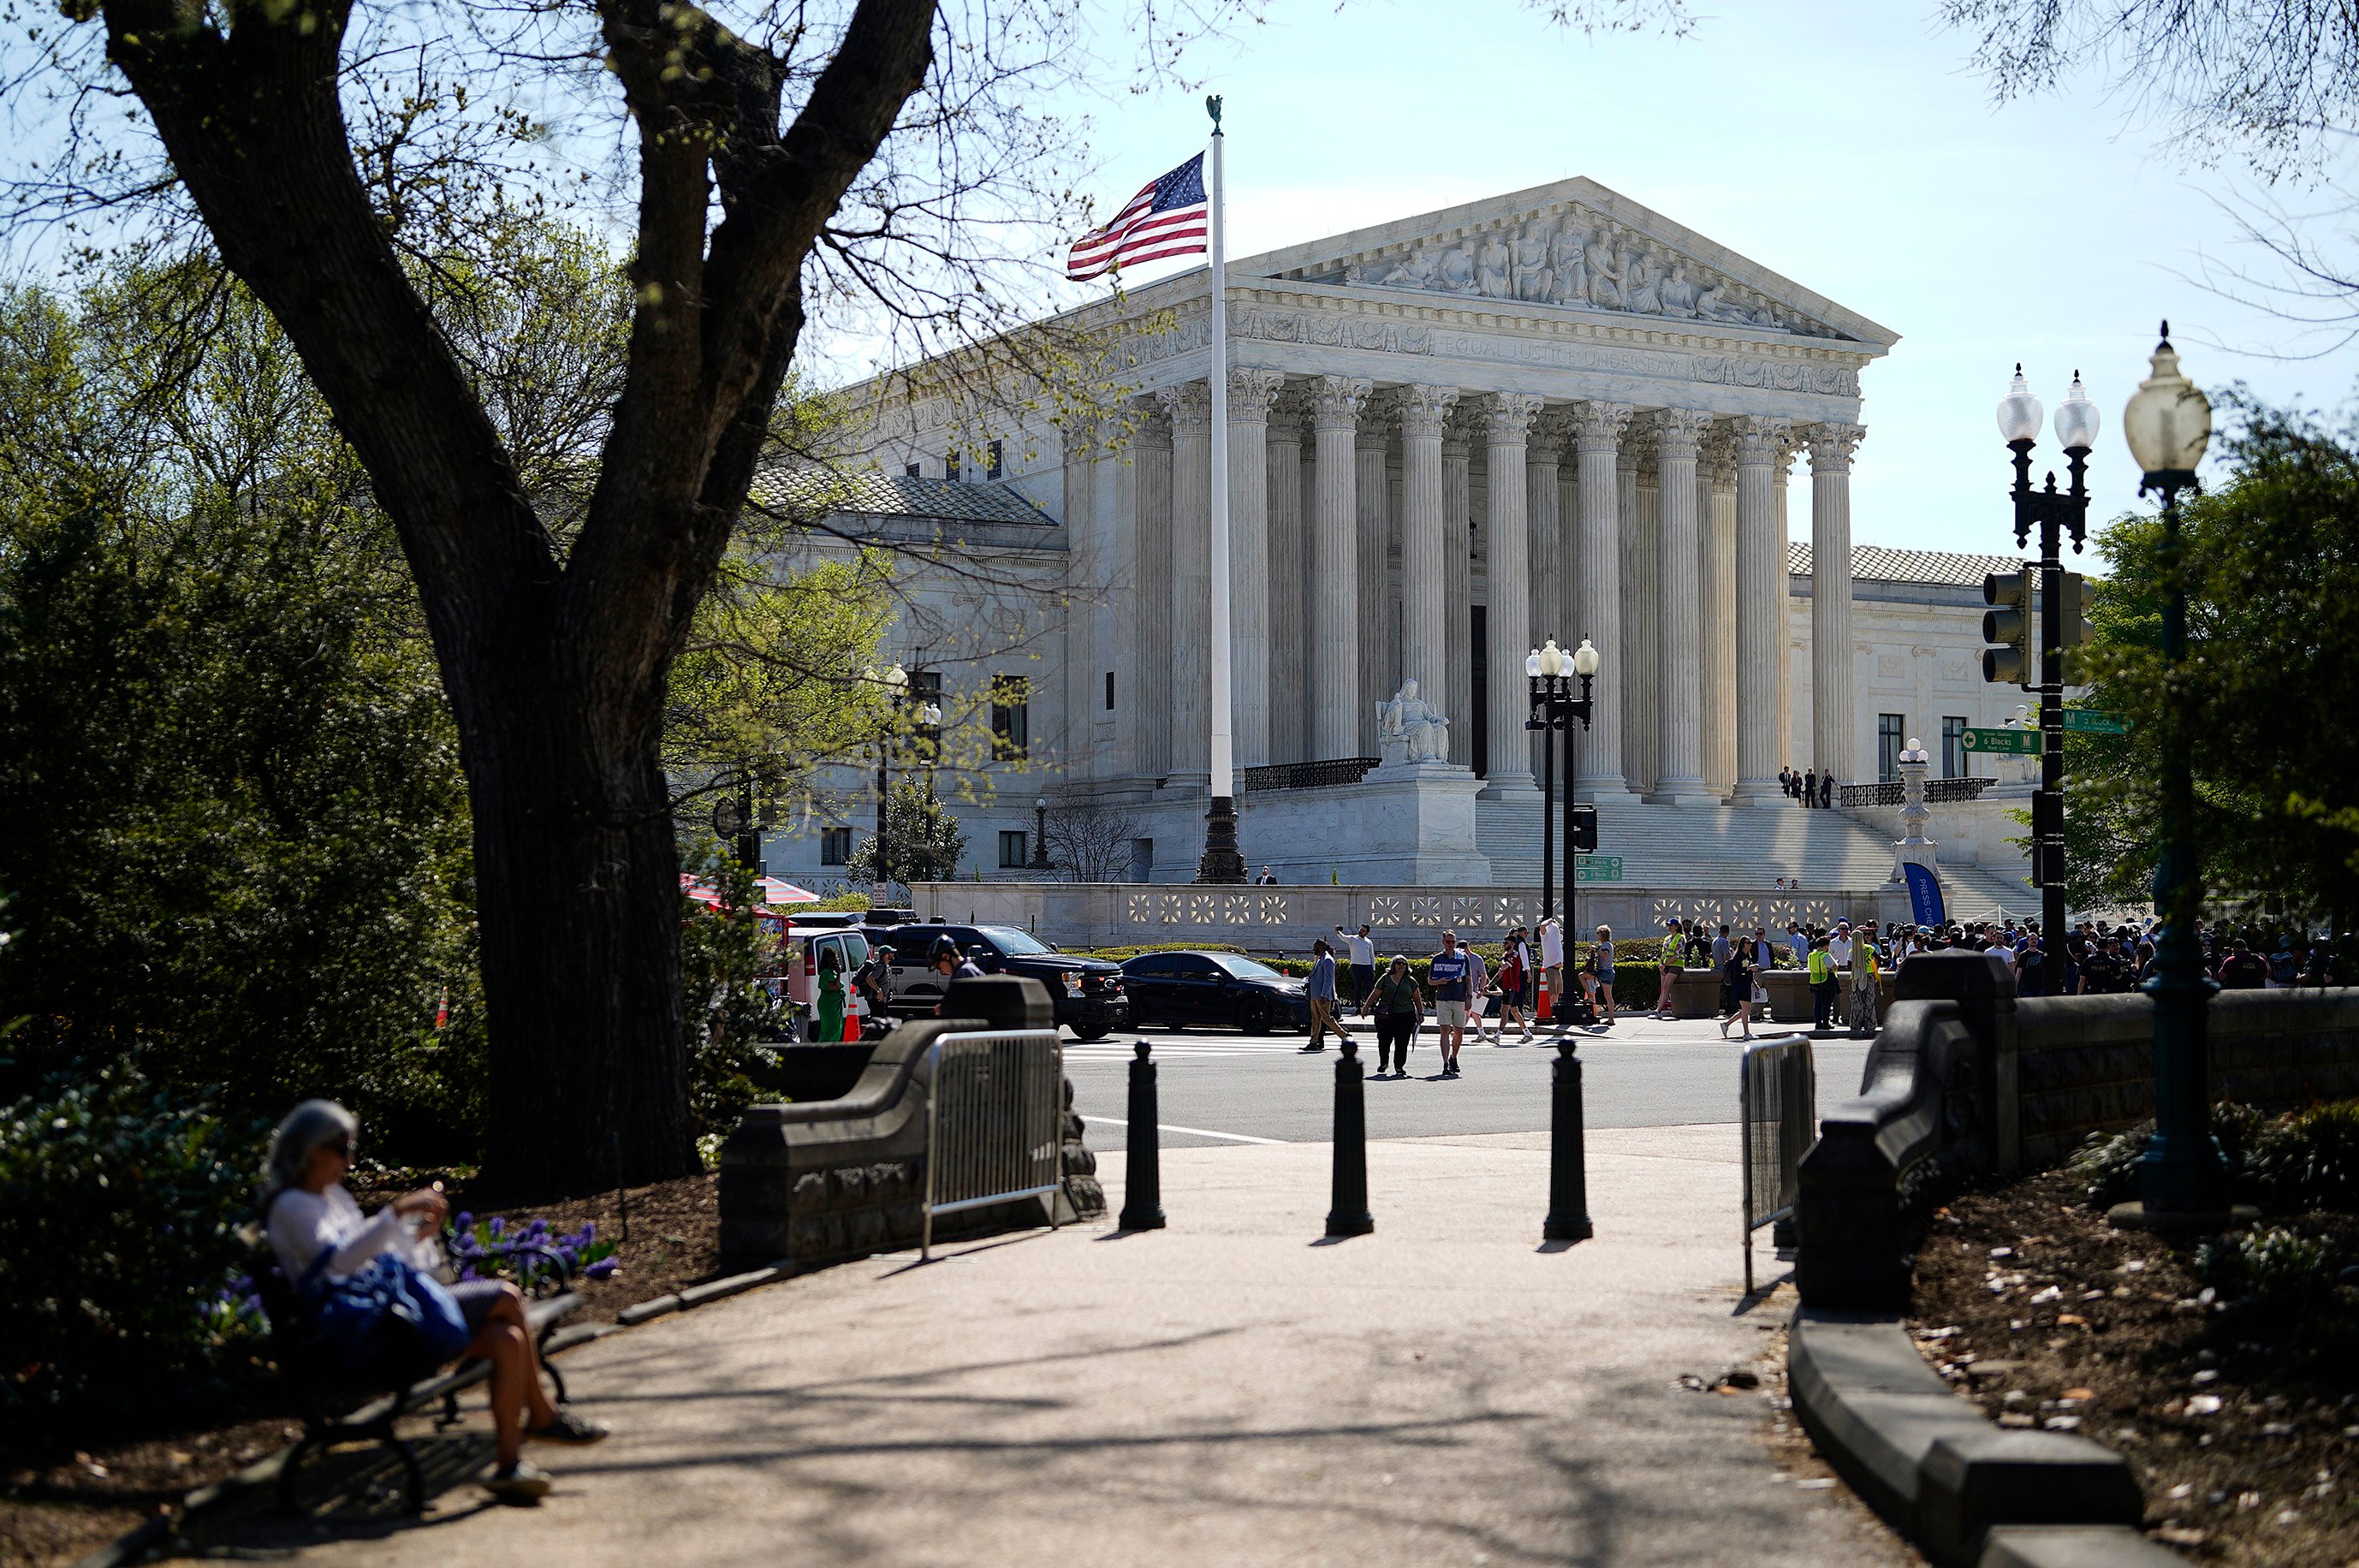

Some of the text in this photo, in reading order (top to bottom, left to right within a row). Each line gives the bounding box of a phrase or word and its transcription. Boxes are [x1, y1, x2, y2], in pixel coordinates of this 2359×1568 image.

[1446, 336, 1679, 374] EQUAL JUSTICE UNDER LAW
[2065, 712, 2076, 724] M
[1990, 737, 2011, 745] Blocks
[2023, 735, 2031, 747] M
[1918, 878, 1934, 926] PRESS CHE
